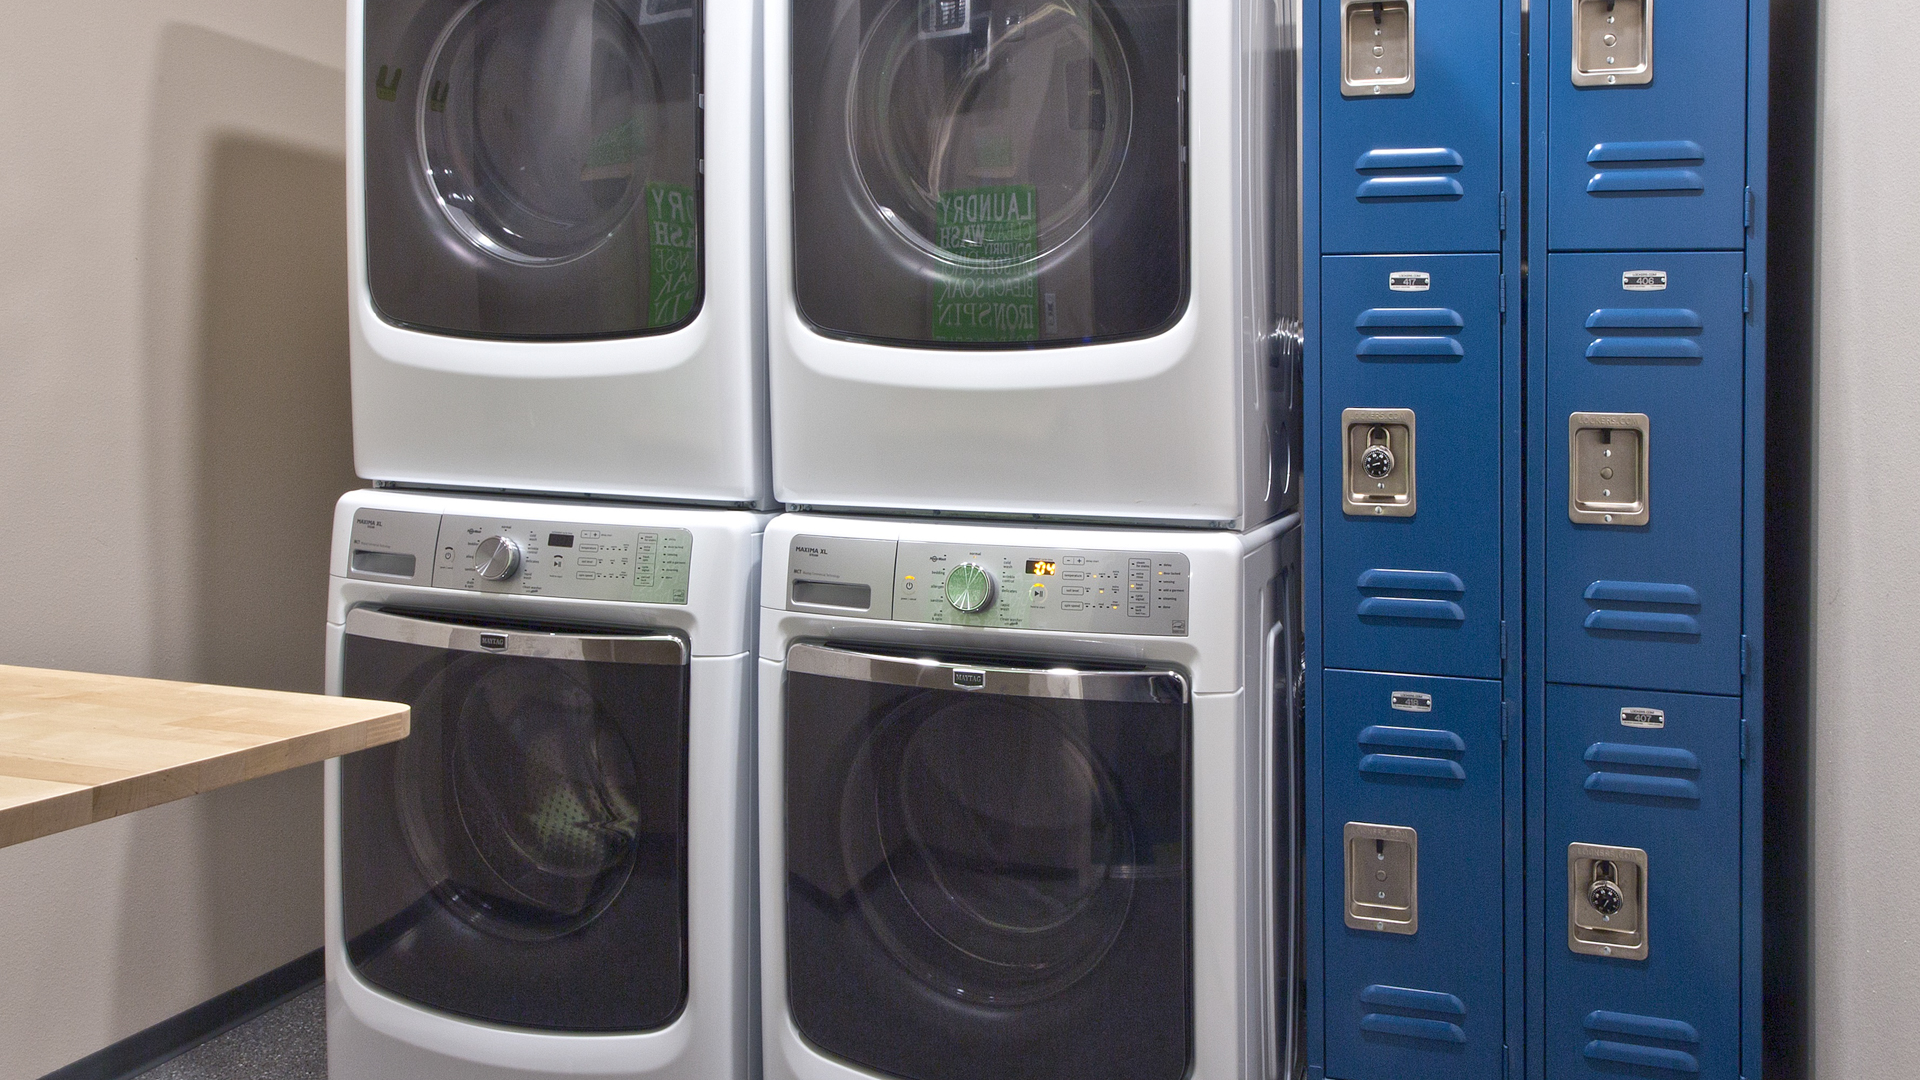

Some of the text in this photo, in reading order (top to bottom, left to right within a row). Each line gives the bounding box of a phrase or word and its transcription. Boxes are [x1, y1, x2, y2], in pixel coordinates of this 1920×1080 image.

[1402, 278, 1417, 286] 417
[1636, 277, 1655, 285] 406
[356, 519, 375, 527] MAXIMA
[795, 546, 819, 554] MAXIMA
[482, 637, 503, 645] MAYTAG
[956, 674, 981, 682] MAYTAG
[1634, 714, 1652, 722] 407
